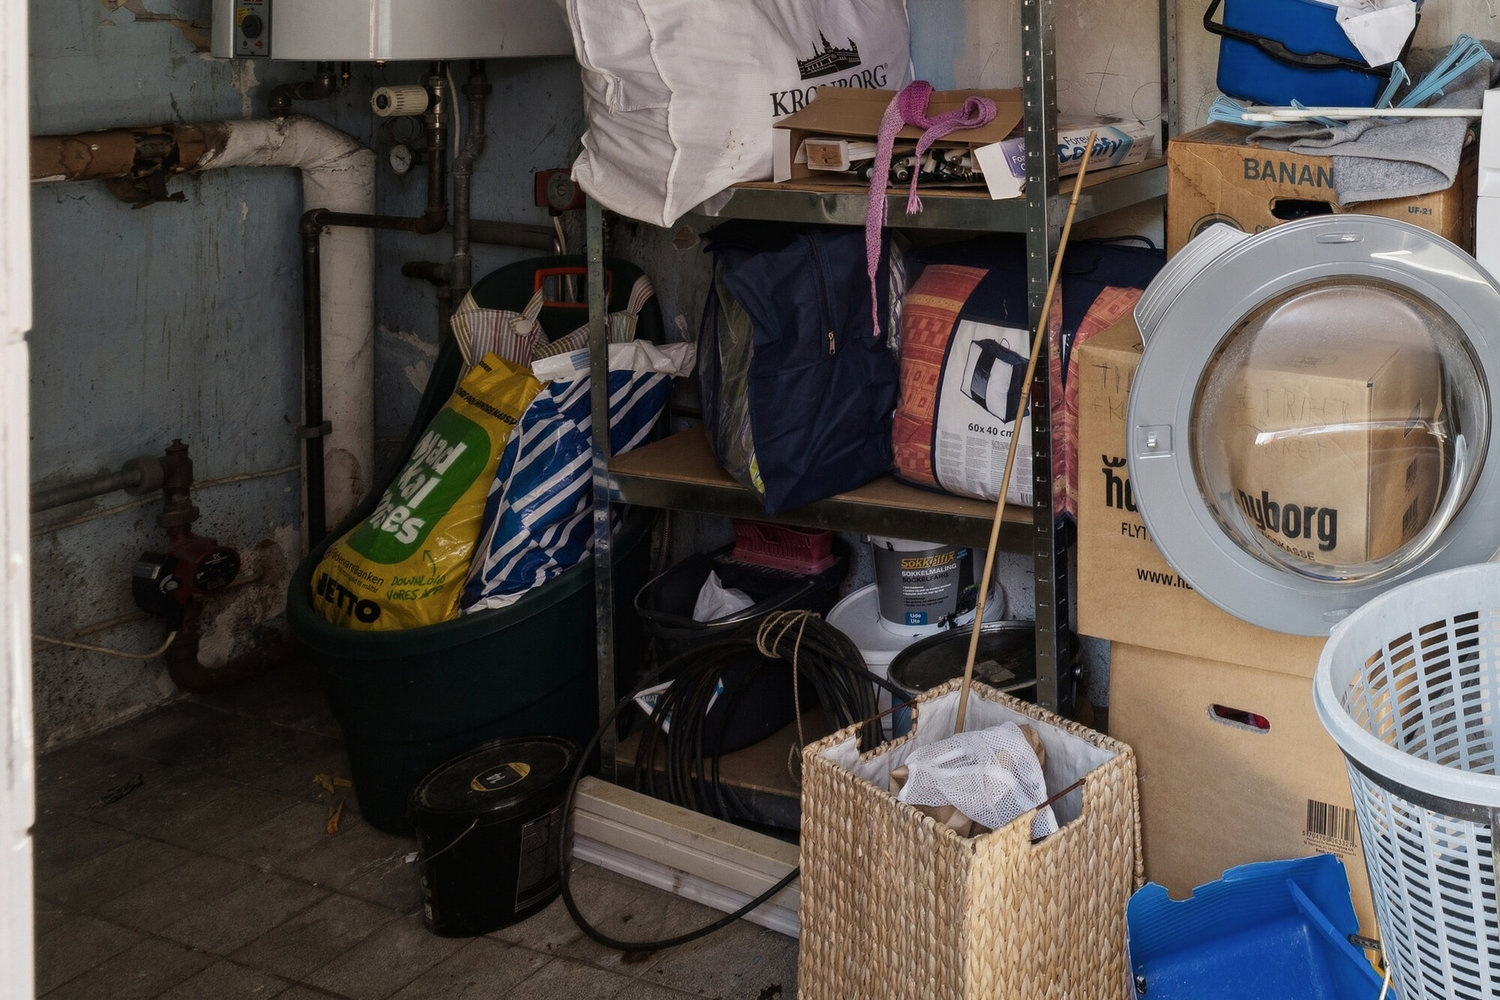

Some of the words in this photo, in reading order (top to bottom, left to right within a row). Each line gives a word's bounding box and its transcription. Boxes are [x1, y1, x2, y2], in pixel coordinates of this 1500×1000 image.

[1243, 157, 1334, 189] BANAN
[1407, 205, 1433, 216] UF-21
[901, 563, 957, 577] SOKKELMALING
[386, 589, 418, 600] VORES
